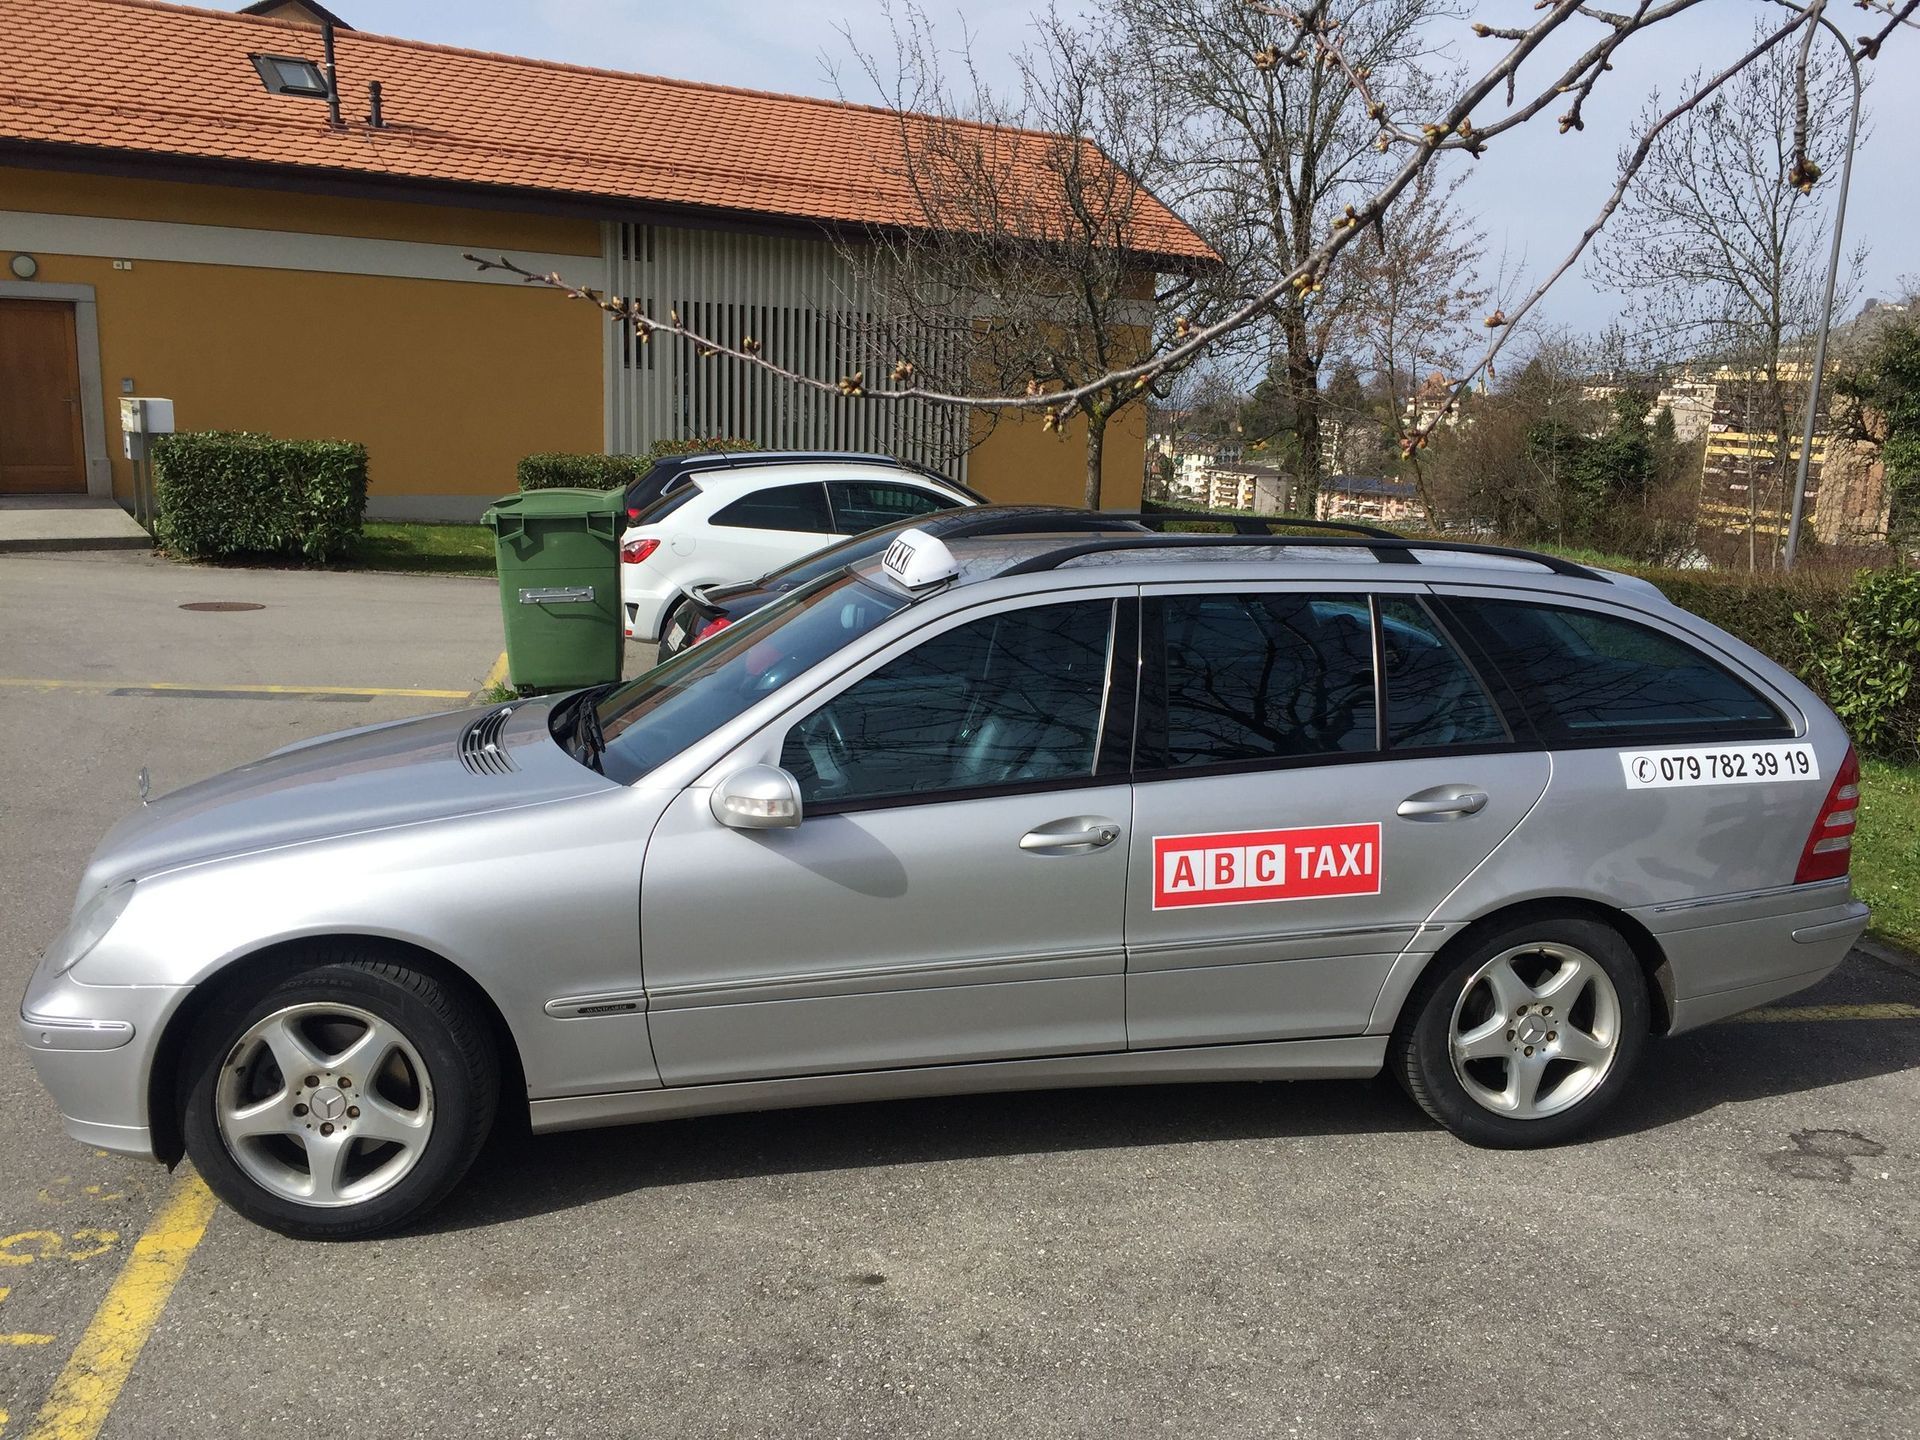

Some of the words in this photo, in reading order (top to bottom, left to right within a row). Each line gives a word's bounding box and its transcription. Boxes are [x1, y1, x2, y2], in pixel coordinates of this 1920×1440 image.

[884, 540, 915, 575] TAXI
[1660, 755, 1701, 782] 079
[1705, 753, 1748, 779] 782
[1751, 751, 1779, 777] 39
[1784, 750, 1810, 775] 19
[1171, 849, 1276, 889] ABC
[1294, 842, 1373, 880] TAXI
